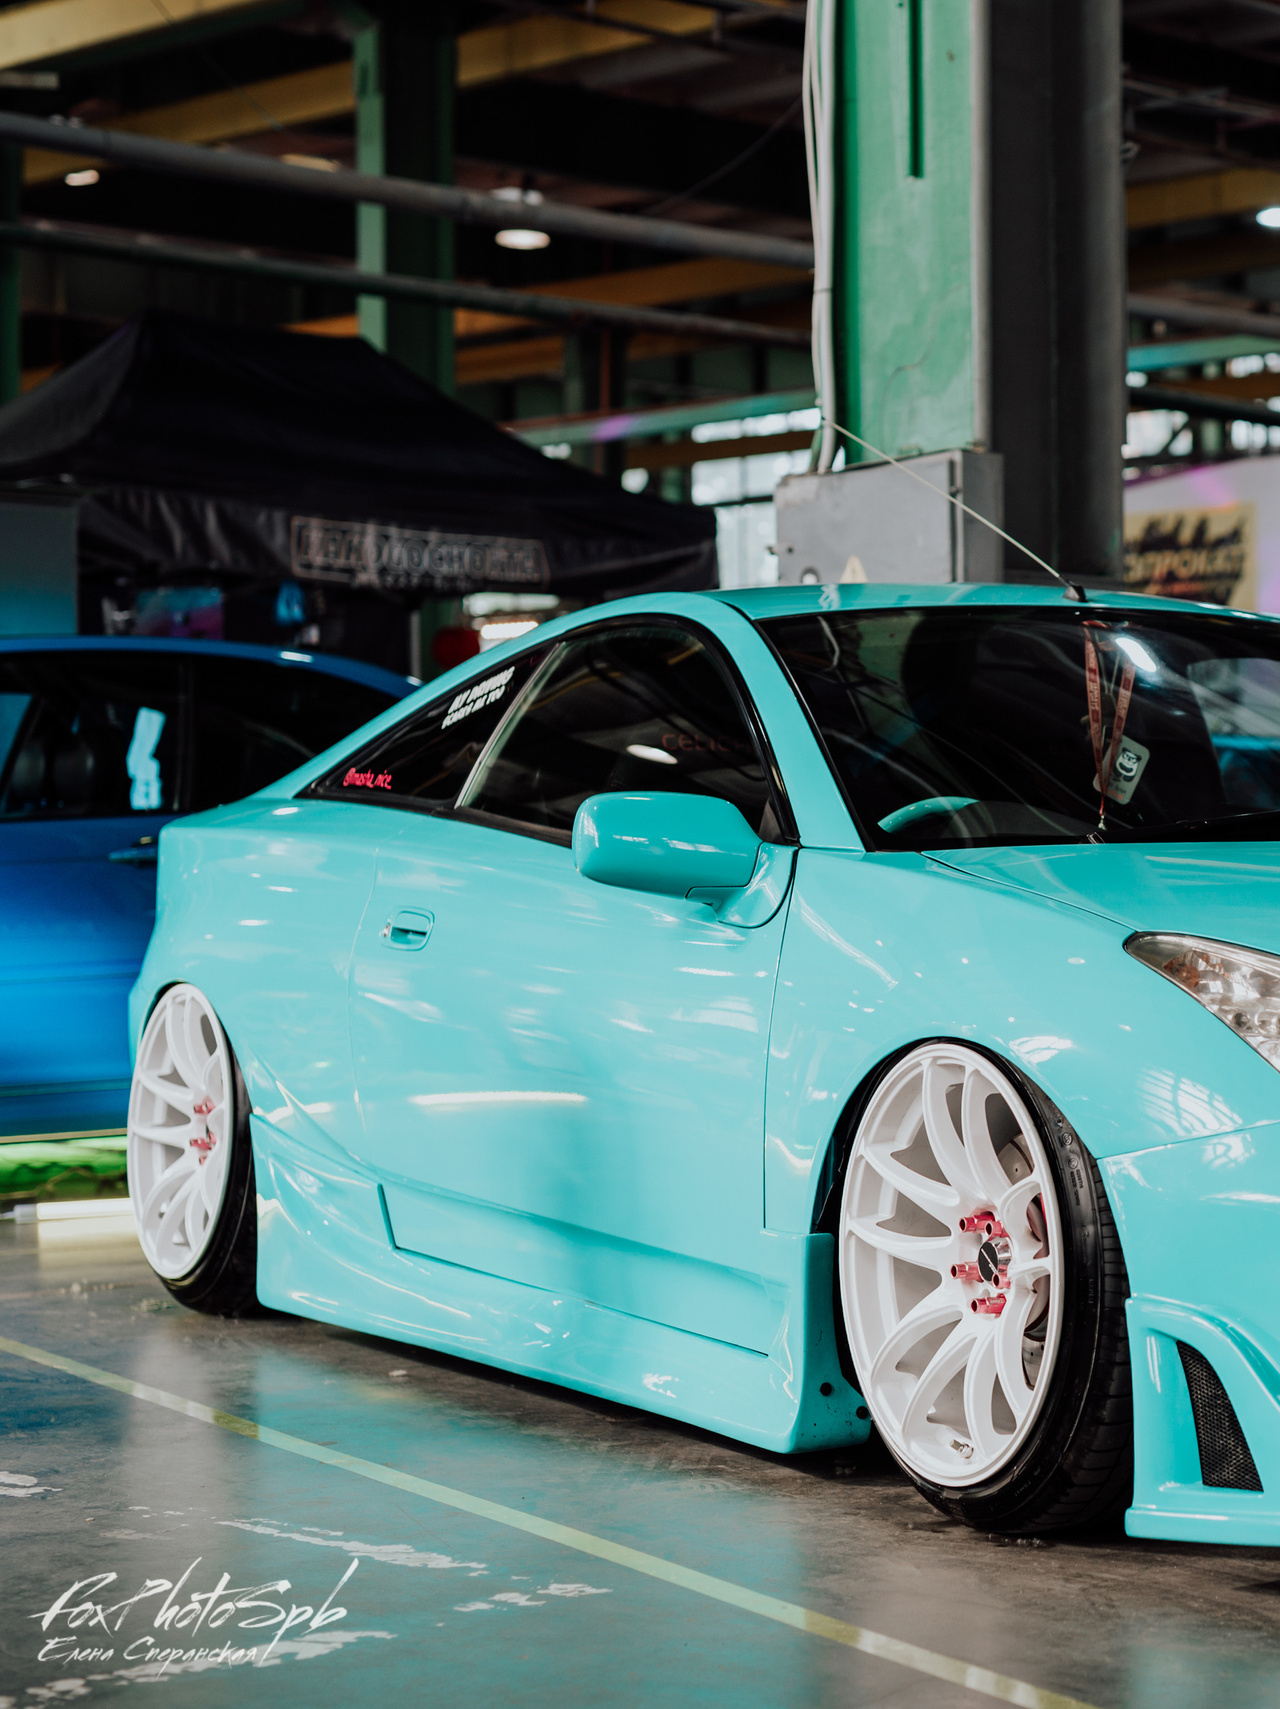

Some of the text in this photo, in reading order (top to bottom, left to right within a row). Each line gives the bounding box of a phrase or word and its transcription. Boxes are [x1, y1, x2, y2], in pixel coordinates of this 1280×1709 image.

[448, 666, 515, 714] MY DRIVING
[486, 685, 505, 705] TOO
